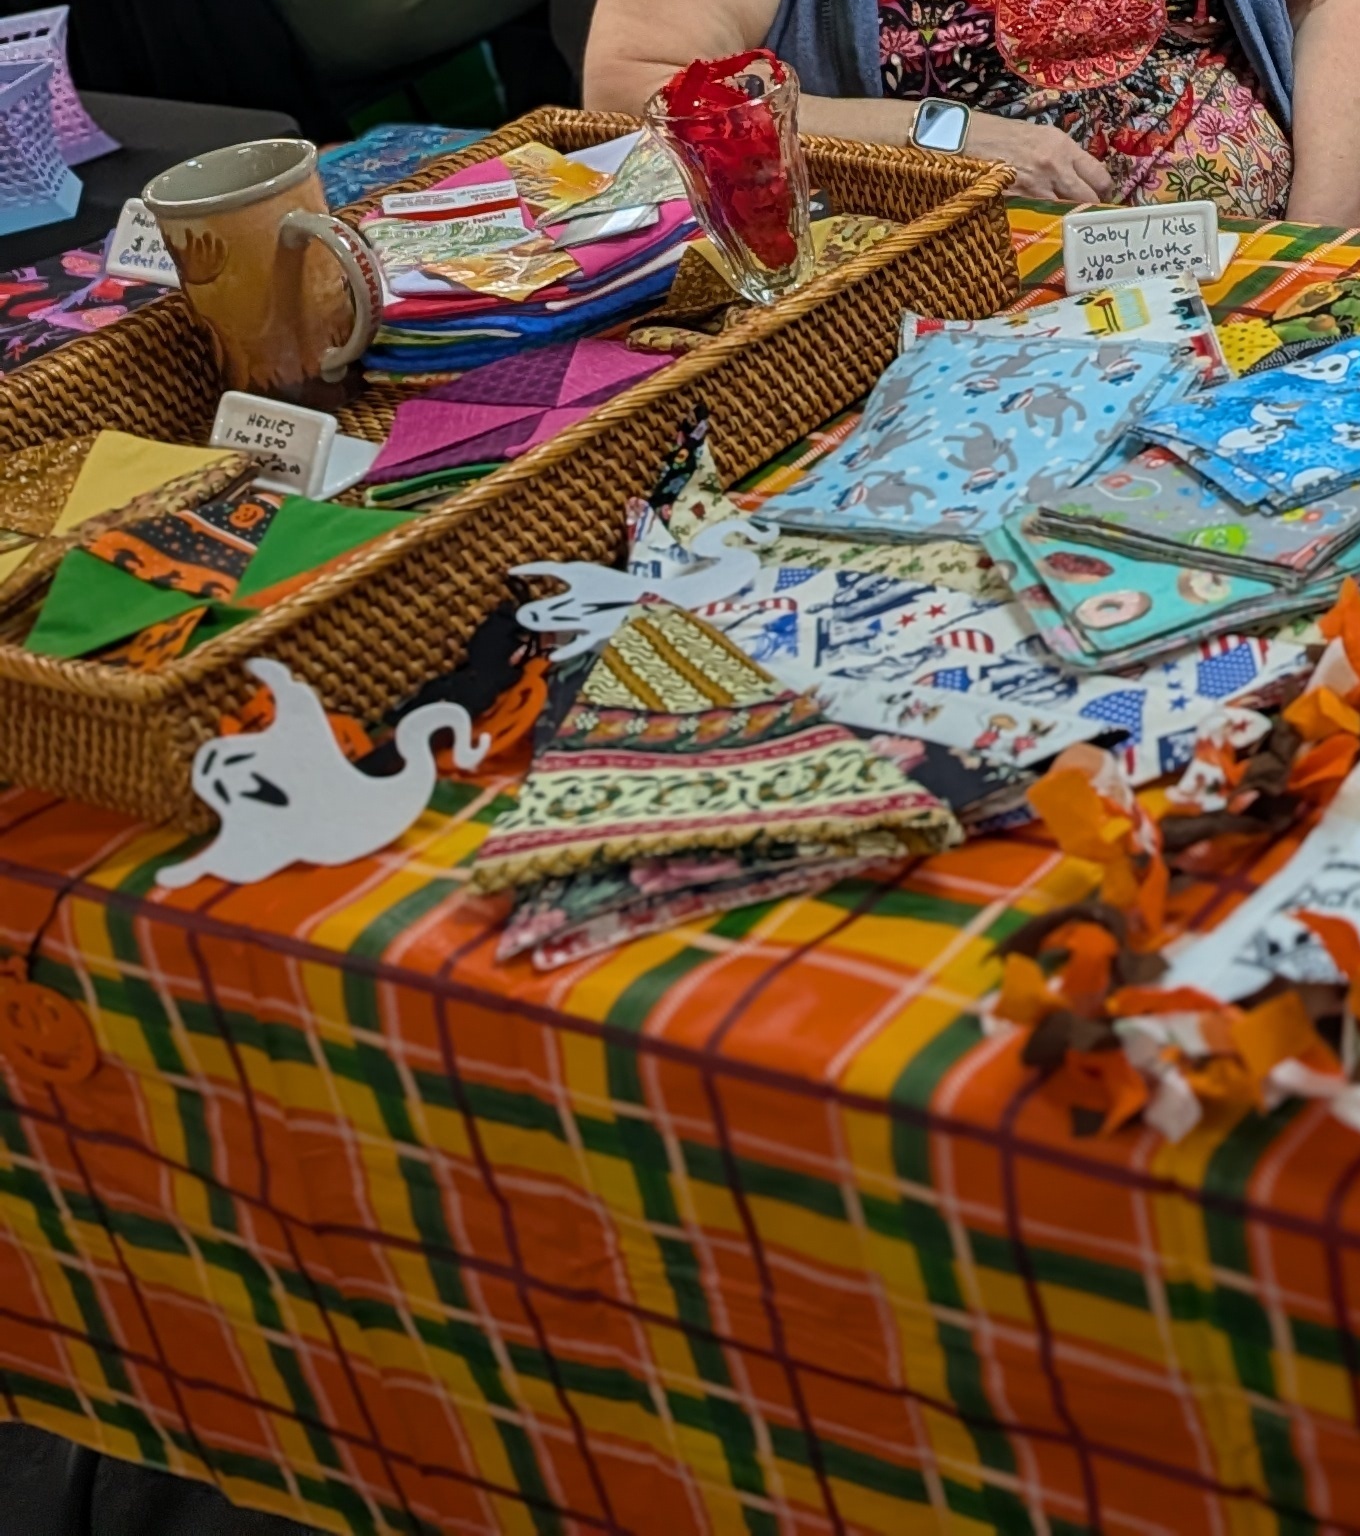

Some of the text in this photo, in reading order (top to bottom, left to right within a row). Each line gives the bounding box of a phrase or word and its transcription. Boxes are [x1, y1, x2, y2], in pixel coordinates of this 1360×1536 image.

[1077, 226, 1129, 247] Baby
[1162, 217, 1197, 236] Kids
[246, 413, 295, 437] HEXIES
